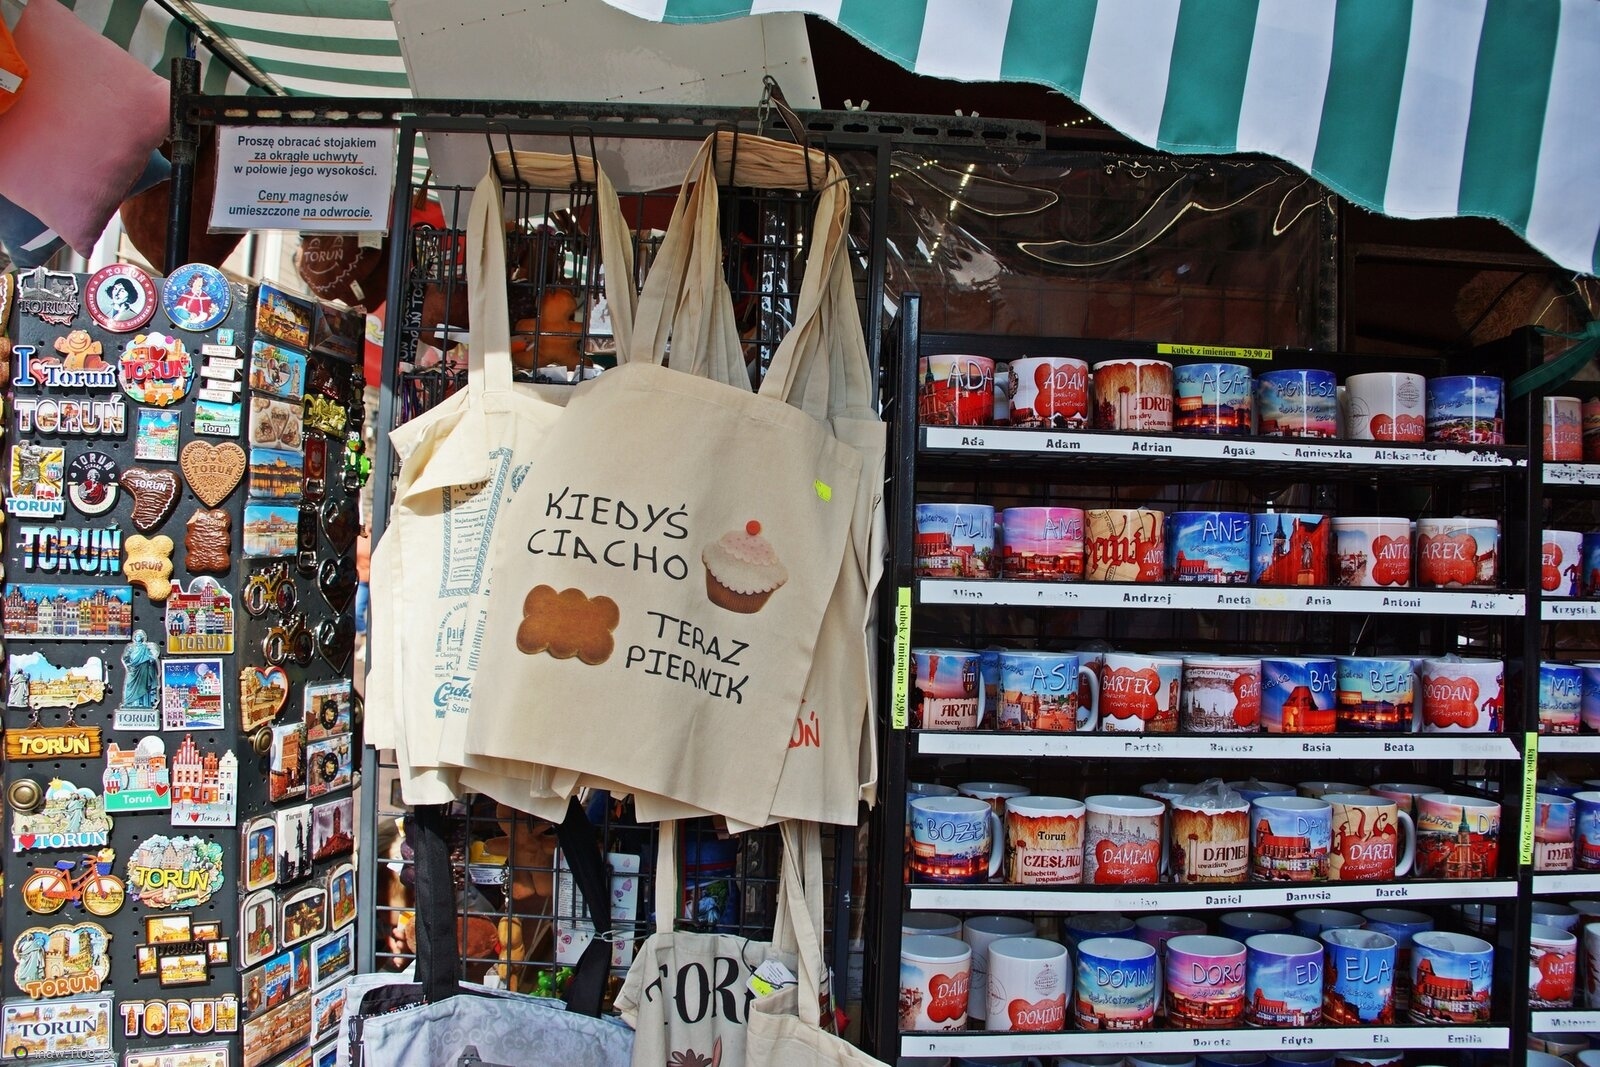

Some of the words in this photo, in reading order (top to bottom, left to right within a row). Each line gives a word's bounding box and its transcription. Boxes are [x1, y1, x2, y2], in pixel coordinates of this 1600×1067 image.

[238, 135, 274, 148] Proszę
[277, 136, 321, 148] obracać
[324, 137, 377, 149] stojakiem
[254, 152, 266, 160] za
[269, 150, 310, 162] okrągłe
[312, 151, 358, 163] uchwyty
[234, 166, 243, 174] w
[246, 164, 287, 176] połowie
[289, 166, 314, 177] jego
[317, 166, 377, 178] wysokości.
[258, 190, 287, 203] Ceny
[289, 191, 348, 204] magnesów
[229, 205, 300, 217] umieszczone
[303, 208, 317, 217] na
[319, 206, 373, 218] odwrocie.
[1170, 346, 1195, 355] kubek
[1202, 347, 1237, 357] imieniem
[13, 346, 35, 387] I
[44, 366, 117, 388] Toruń
[14, 394, 126, 434] TORUŃ
[203, 423, 231, 434] Toruń
[961, 436, 985, 446] Ada
[1046, 438, 1081, 449] Adam
[1132, 441, 1173, 453] Adrian
[1295, 447, 1353, 459] Agnieszka
[546, 487, 689, 540] KIEDYŚ
[20, 523, 121, 574] TORUŃ
[527, 529, 689, 581] CIACHO
[1421, 541, 1465, 561] AREK
[1123, 592, 1172, 605] Andrzej
[1217, 594, 1251, 605] Aneta
[1306, 595, 1332, 606] Ania
[1382, 597, 1421, 608] Antoni
[899, 604, 908, 632] kubek
[647, 611, 750, 666] TERAZ
[899, 633, 905, 641] z
[897, 642, 908, 684] imieniem
[625, 645, 749, 704] PIERNIK
[1102, 675, 1153, 696] BARTEK
[896, 692, 906, 717] 29,90
[896, 718, 905, 727] zł
[19, 731, 92, 755] TORUŃ
[1302, 742, 1331, 753] Basia
[1384, 742, 1415, 752] Beata
[1526, 748, 1536, 774] kubek
[122, 793, 153, 805] Toruń
[1524, 784, 1535, 823] imieniem
[34, 827, 108, 849] TORUŃ
[1037, 830, 1066, 841] Toruń
[1102, 848, 1154, 865] DAMIAN
[1203, 845, 1248, 862] DANIEL
[135, 865, 210, 891] TORUŃ
[1286, 890, 1331, 902] Danusia
[1376, 887, 1408, 898] Darek
[1205, 894, 1242, 906] Daniel
[1345, 956, 1392, 984] ELA
[26, 971, 100, 999] TORUŃ
[120, 993, 238, 1037] TORUŃ
[18, 1015, 98, 1038] TORUŃ
[1372, 1034, 1390, 1044] Ela
[1447, 1034, 1482, 1044] Emilia
